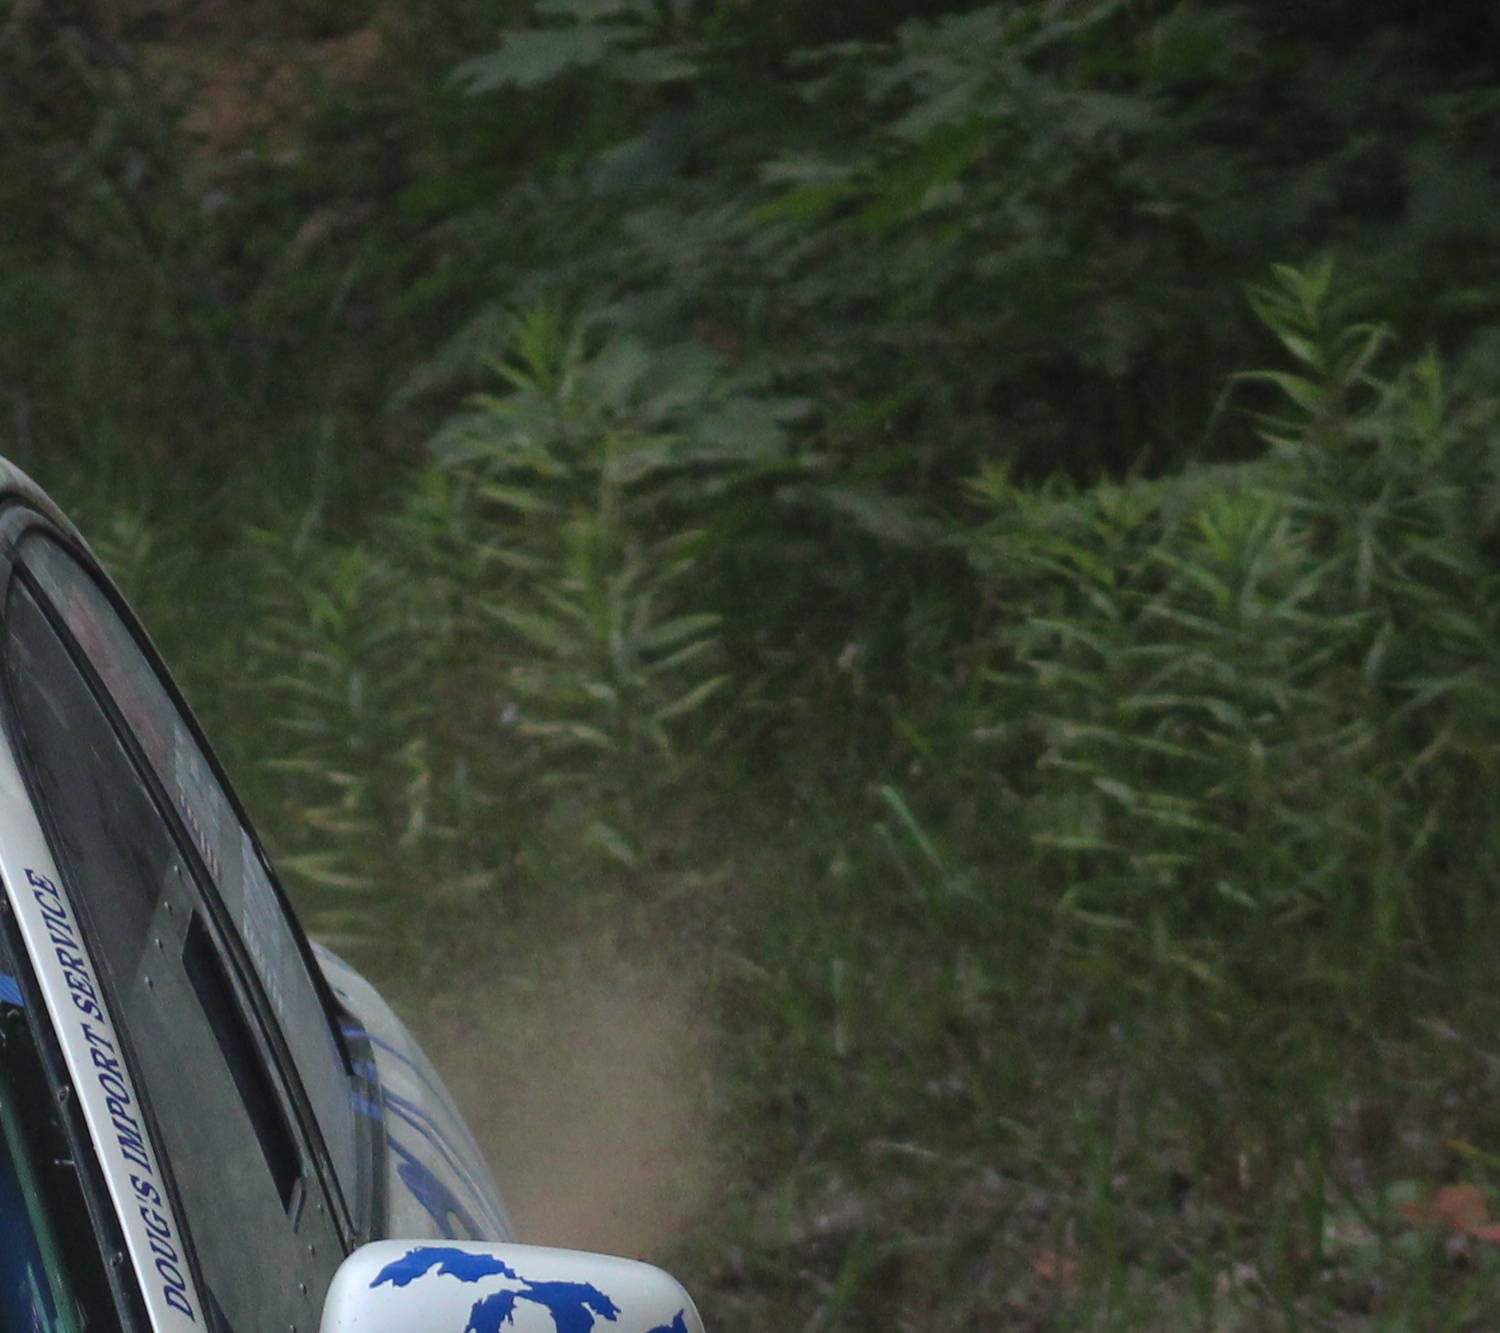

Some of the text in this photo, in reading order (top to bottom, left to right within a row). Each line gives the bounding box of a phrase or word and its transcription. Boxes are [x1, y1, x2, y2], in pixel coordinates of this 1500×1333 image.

[24, 868, 195, 1323] DOUG'S IMPORT SERVICE
